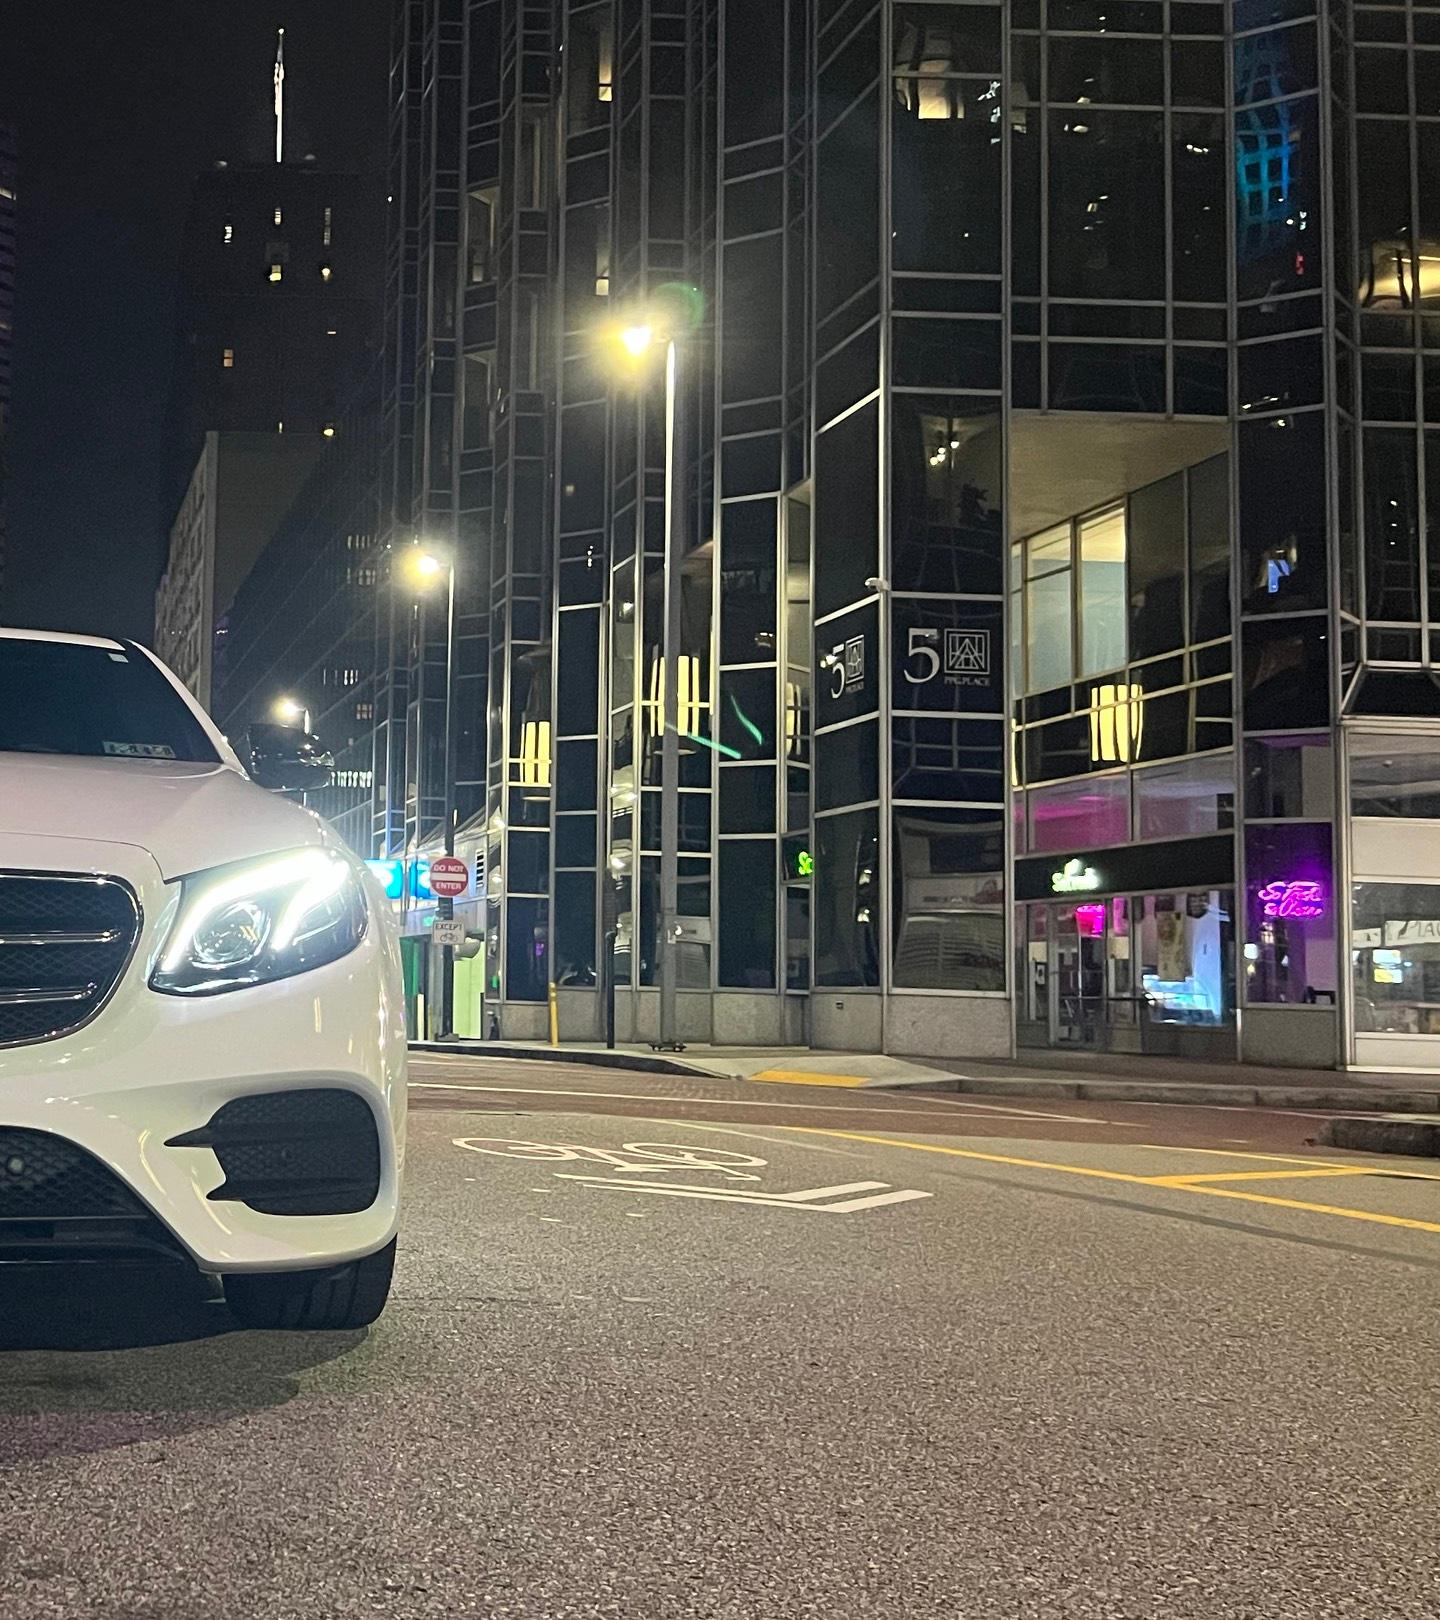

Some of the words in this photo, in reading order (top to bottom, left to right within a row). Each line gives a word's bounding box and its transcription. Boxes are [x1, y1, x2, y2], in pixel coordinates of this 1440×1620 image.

[903, 627, 940, 684] 5
[436, 882, 462, 890] ENTER
[435, 923, 463, 931] EXCEPT
